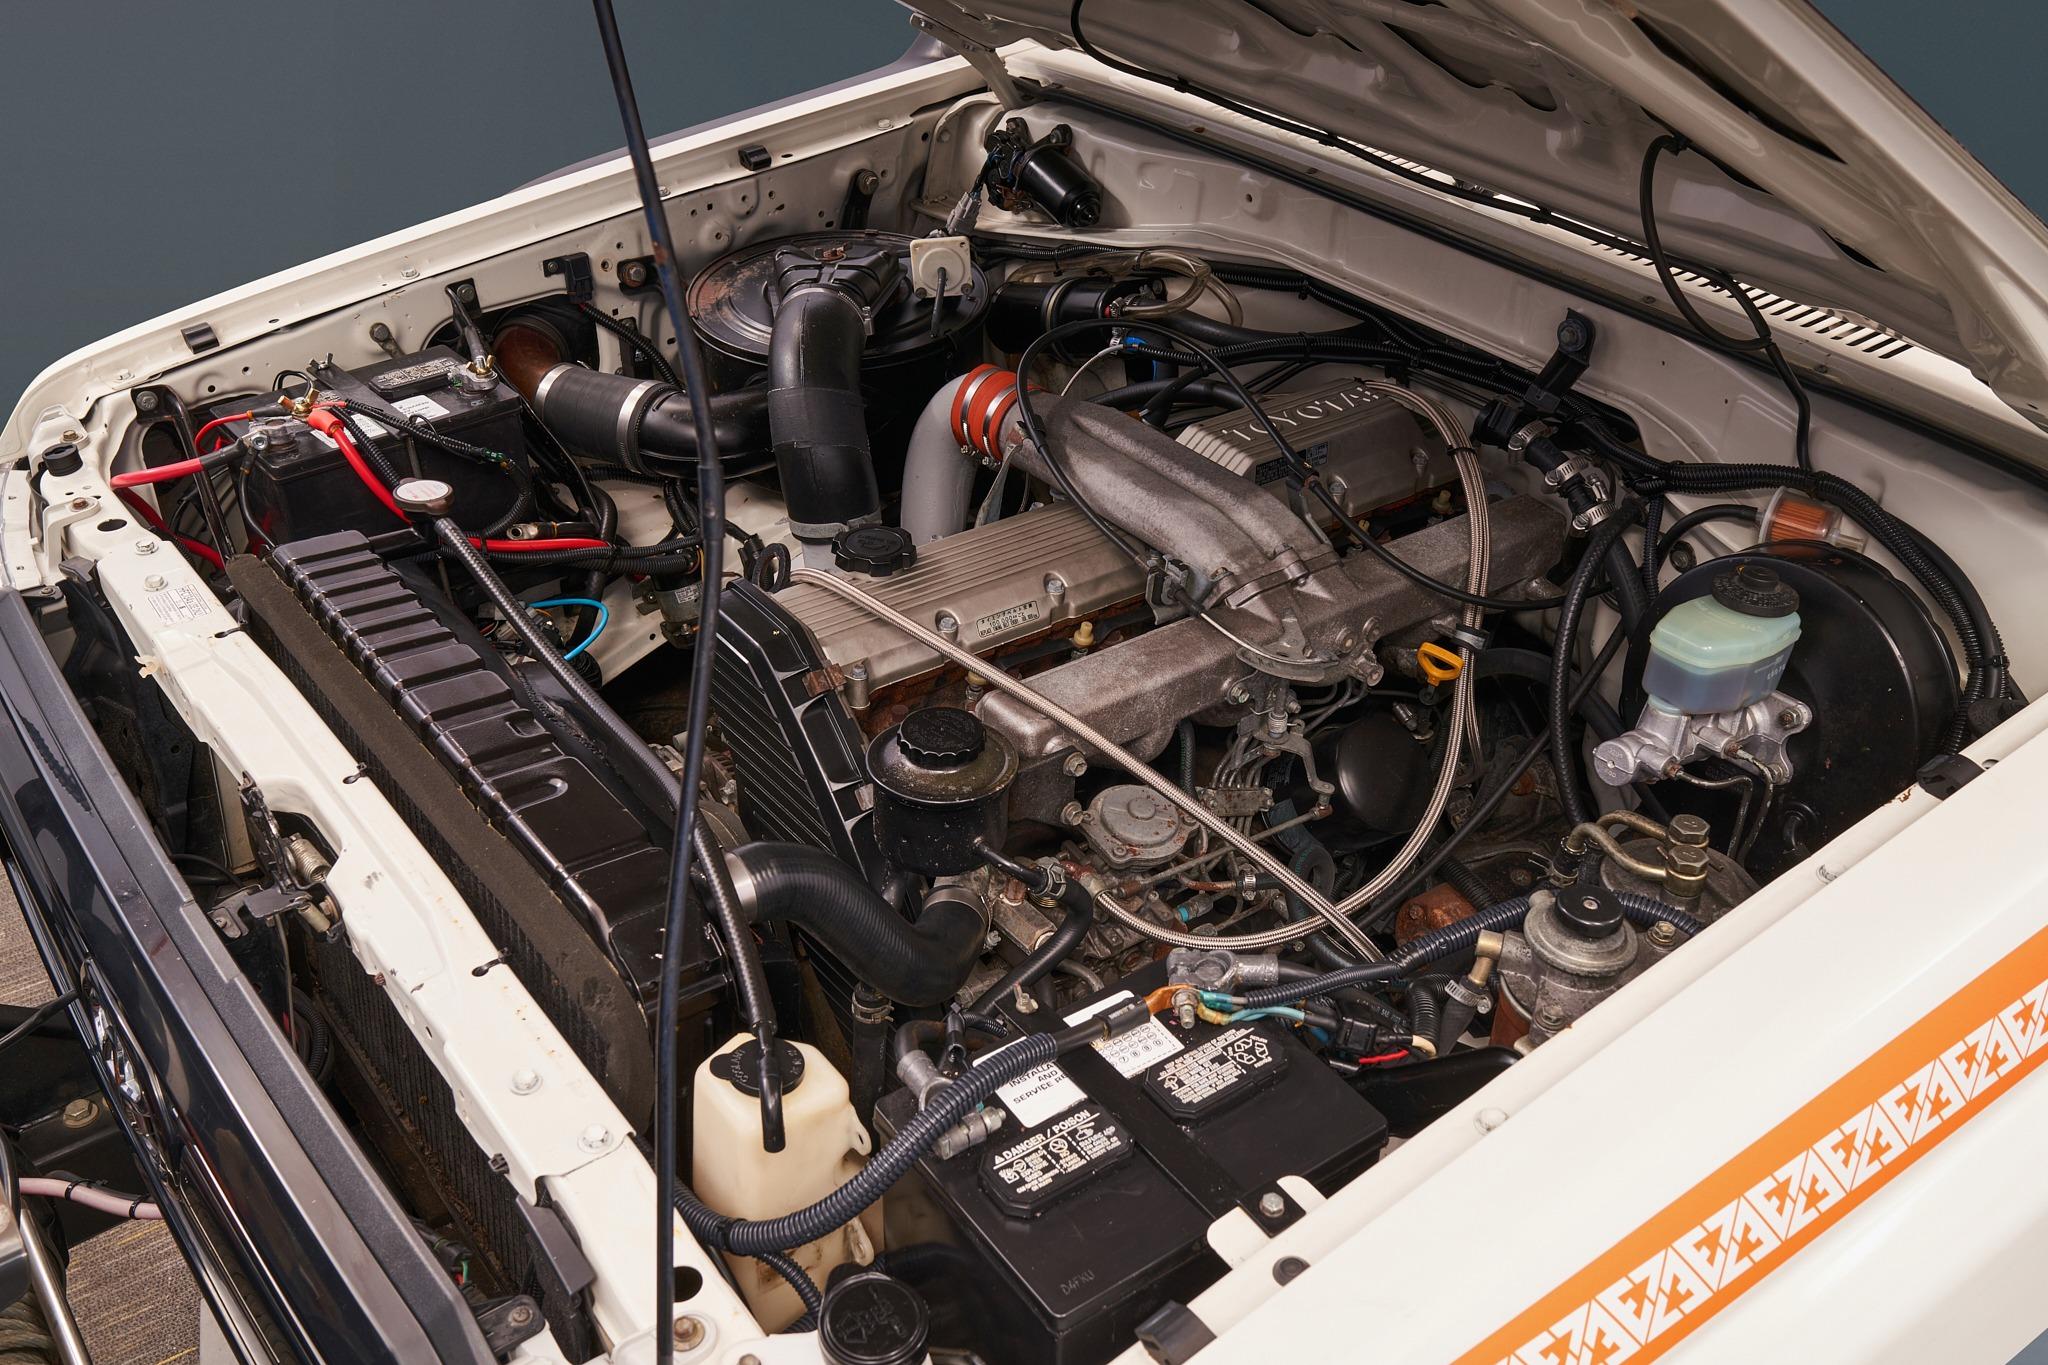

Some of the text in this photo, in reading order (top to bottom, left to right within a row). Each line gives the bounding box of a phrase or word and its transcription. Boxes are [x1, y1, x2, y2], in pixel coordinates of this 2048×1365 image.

[1038, 1070, 1058, 1082] AND
[1013, 1082, 1054, 1103] SERVICE
[1002, 1133, 1047, 1160] DANGER
[1052, 1109, 1091, 1134] POISON
